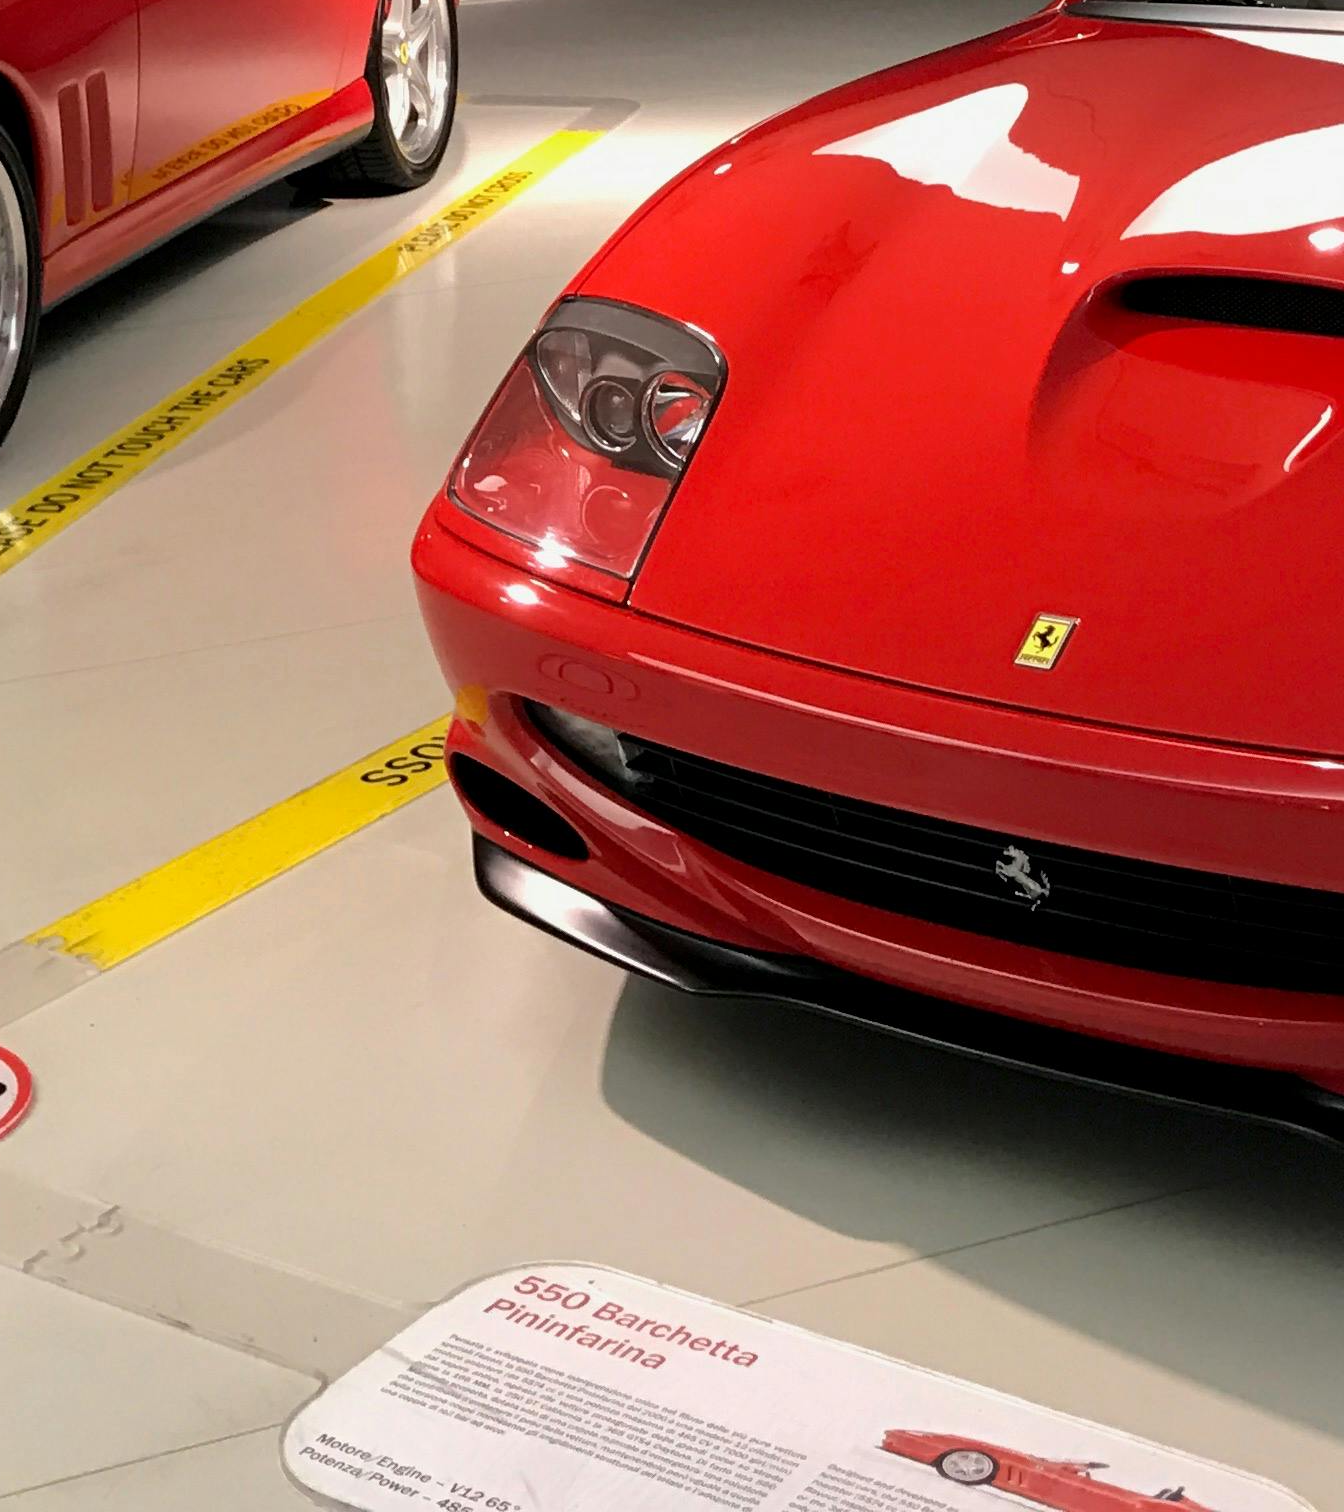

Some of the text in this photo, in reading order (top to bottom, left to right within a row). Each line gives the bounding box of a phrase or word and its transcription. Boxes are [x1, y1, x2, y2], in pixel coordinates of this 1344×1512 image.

[483, 171, 533, 192] CROSS
[26, 491, 81, 516] DO
[60, 459, 124, 490] NOT
[103, 414, 185, 457] TOUCH
[169, 388, 228, 420] THE
[208, 356, 271, 389] CARS
[484, 1297, 667, 1370] Pininfarina
[513, 1275, 759, 1368] 550 Barchetta
[299, 1446, 419, 1496] Potenza/Power
[316, 1433, 432, 1484] Motore/Engine
[450, 1483, 485, 1502] V12
